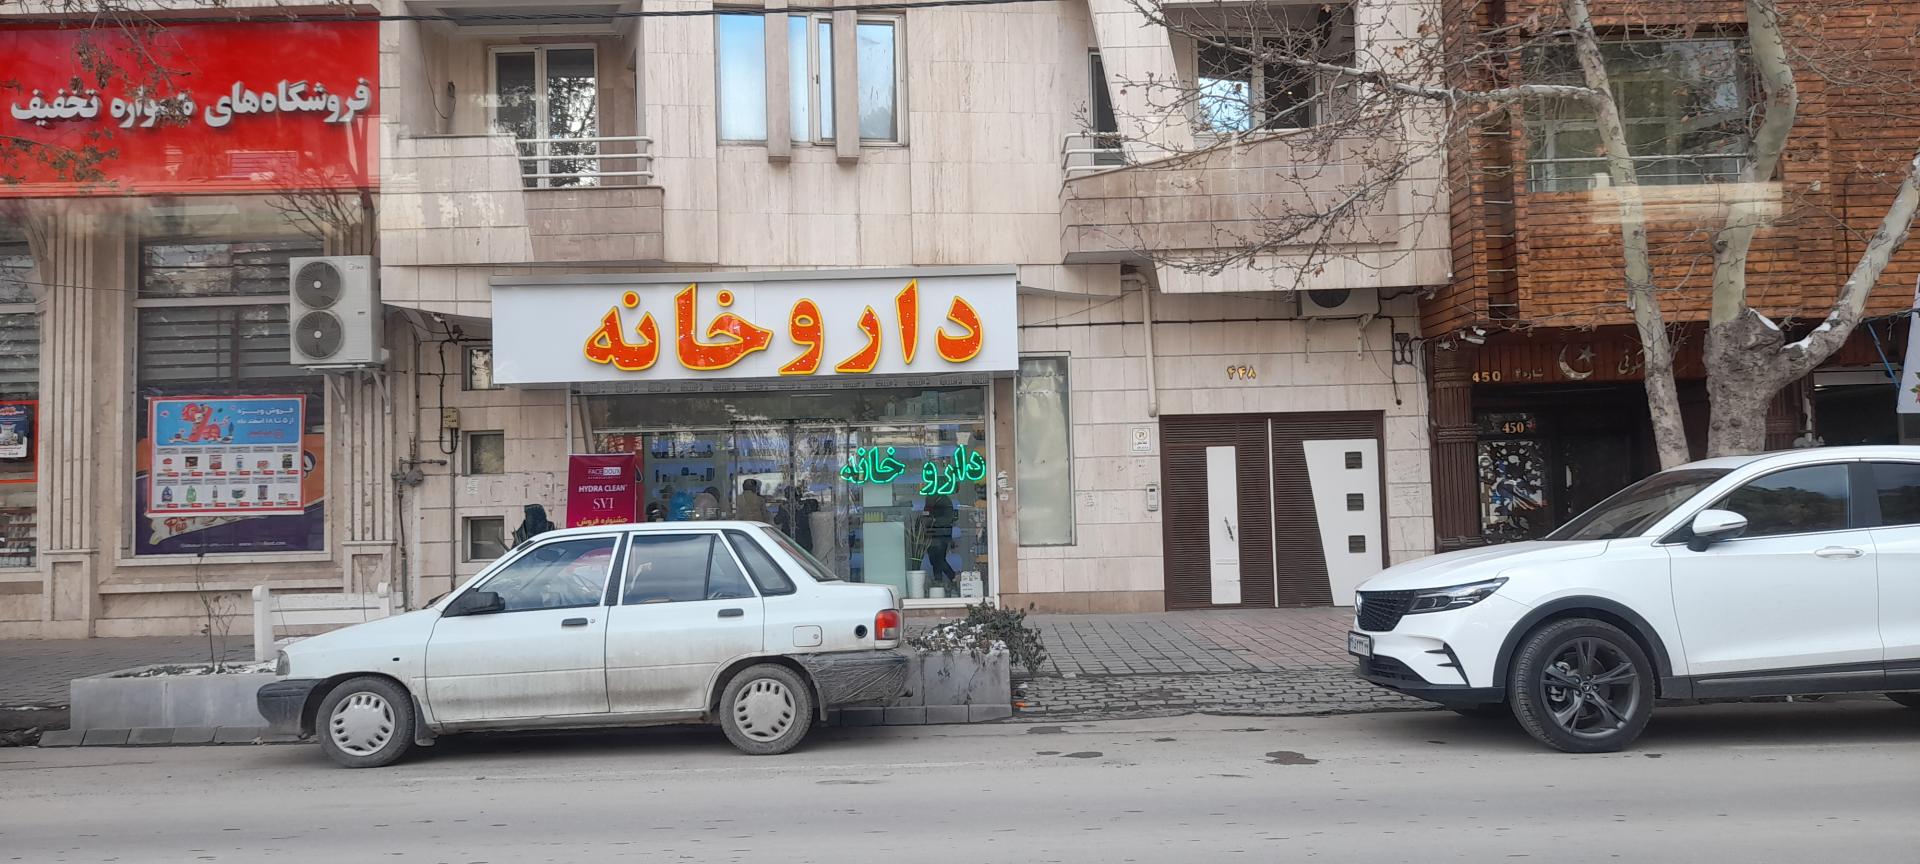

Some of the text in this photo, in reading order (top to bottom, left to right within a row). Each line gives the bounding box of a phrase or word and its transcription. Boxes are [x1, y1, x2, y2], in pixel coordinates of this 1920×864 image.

[11, 87, 100, 127] تخفیف
[1227, 365, 1256, 380] ۴۴۸
[1472, 371, 1501, 382] 450
[1503, 422, 1525, 434] 450
[578, 485, 603, 493] HYDRA
